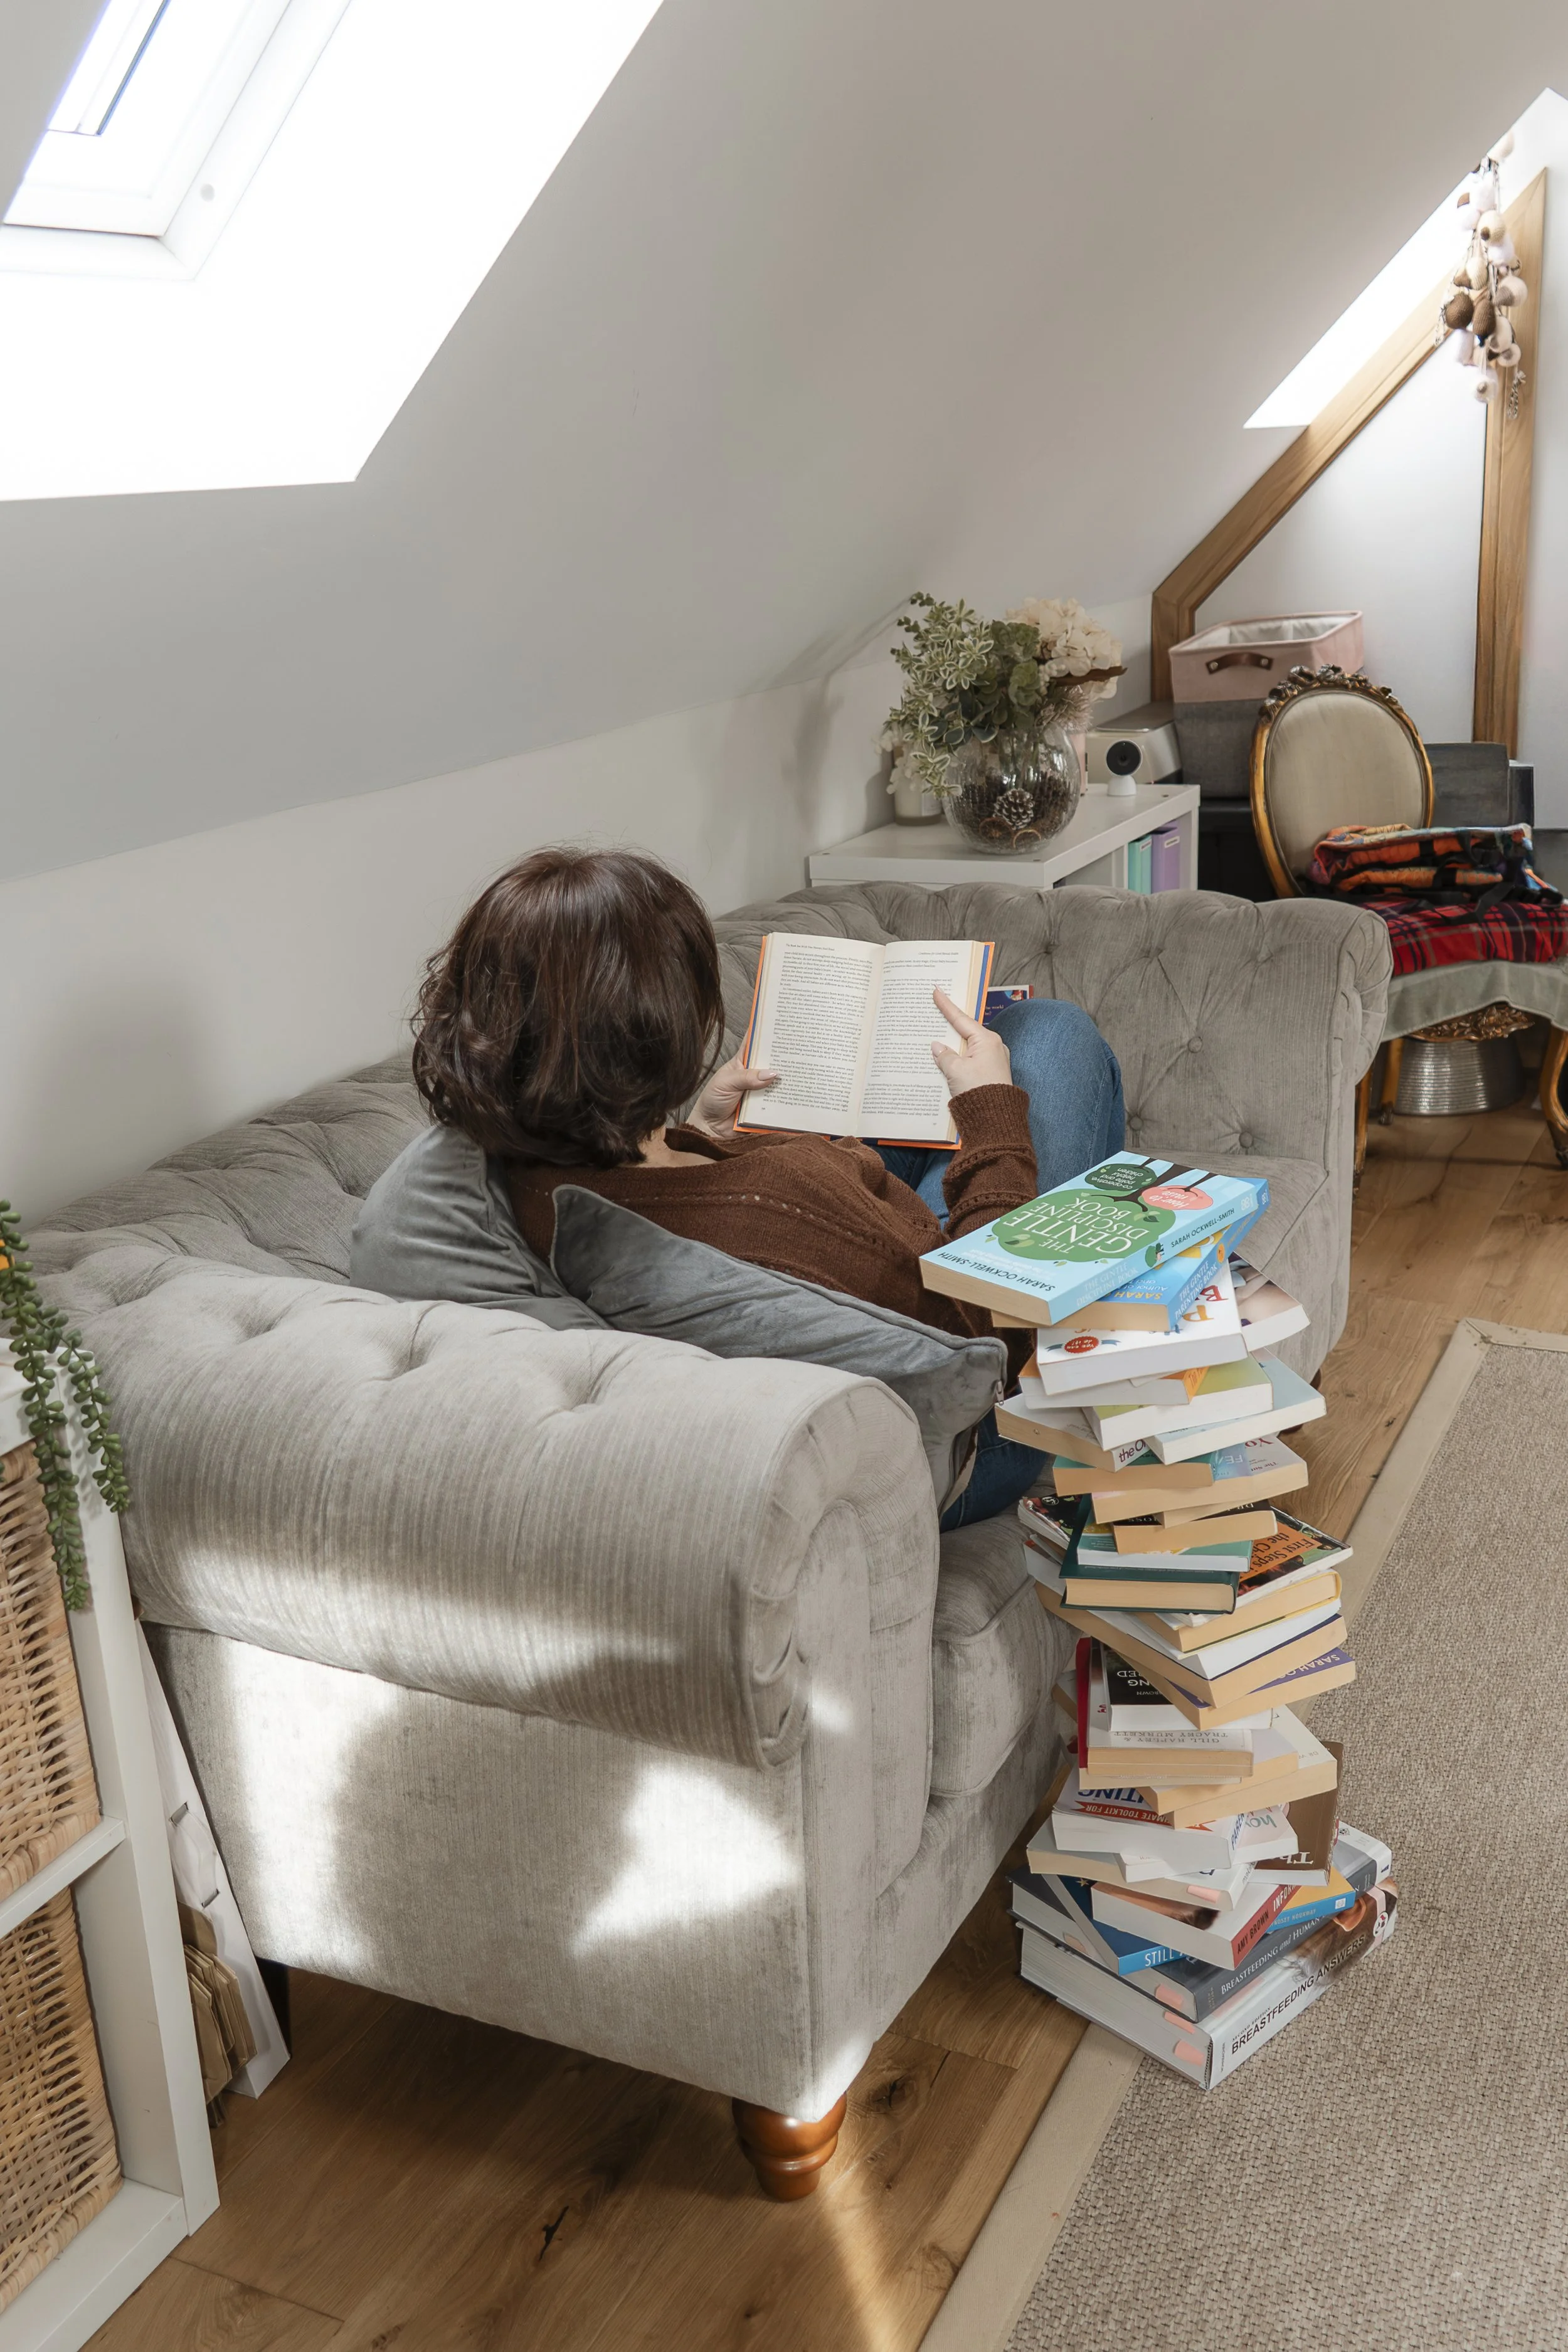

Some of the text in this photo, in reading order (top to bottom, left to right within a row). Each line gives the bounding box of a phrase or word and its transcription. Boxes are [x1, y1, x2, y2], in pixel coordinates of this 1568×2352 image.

[1111, 1172, 1136, 1180] helpful
[1117, 1167, 1144, 1177] children
[1148, 1194, 1190, 1208] How to
[1162, 1190, 1189, 1200] raise
[1065, 1197, 1132, 1221] BOOK
[1030, 1202, 1150, 1240] DISCIPLINE
[1171, 1233, 1190, 1248] SARAH
[1191, 1208, 1235, 1237] OCKWELL-SMITH
[1002, 1210, 1132, 1254] GENTLE
[1039, 1239, 1075, 1254] THE
[937, 1252, 1018, 1280] OCKWELL-SMITH
[1017, 1276, 1056, 1292] SARAH
[1180, 1284, 1190, 1301] THE
[1190, 1261, 1209, 1288] GENTLE
[1114, 1291, 1163, 1300] SARAH
[1175, 1280, 1204, 1320] PARENTING
[1204, 1261, 1218, 1284] BOOK
[1119, 1448, 1135, 1463] the
[1267, 1532, 1290, 1544] the
[1282, 1538, 1315, 1553] First
[1253, 1550, 1288, 1567] Steps
[1298, 1654, 1340, 1672] SARAH
[1086, 1804, 1102, 1814] FOR
[1103, 1806, 1139, 1818] TOOLKIT
[1237, 1934, 1249, 1955] AMY
[1249, 1909, 1269, 1939] BROWN
[1145, 1948, 1175, 1967] STILL
[1221, 1916, 1321, 1995] BREASTFEEDING and HUMAN
[1231, 1934, 1365, 2055] BREASTFEEDING ANSWERS
[1232, 2006, 1272, 2041] SECOND EDITION
